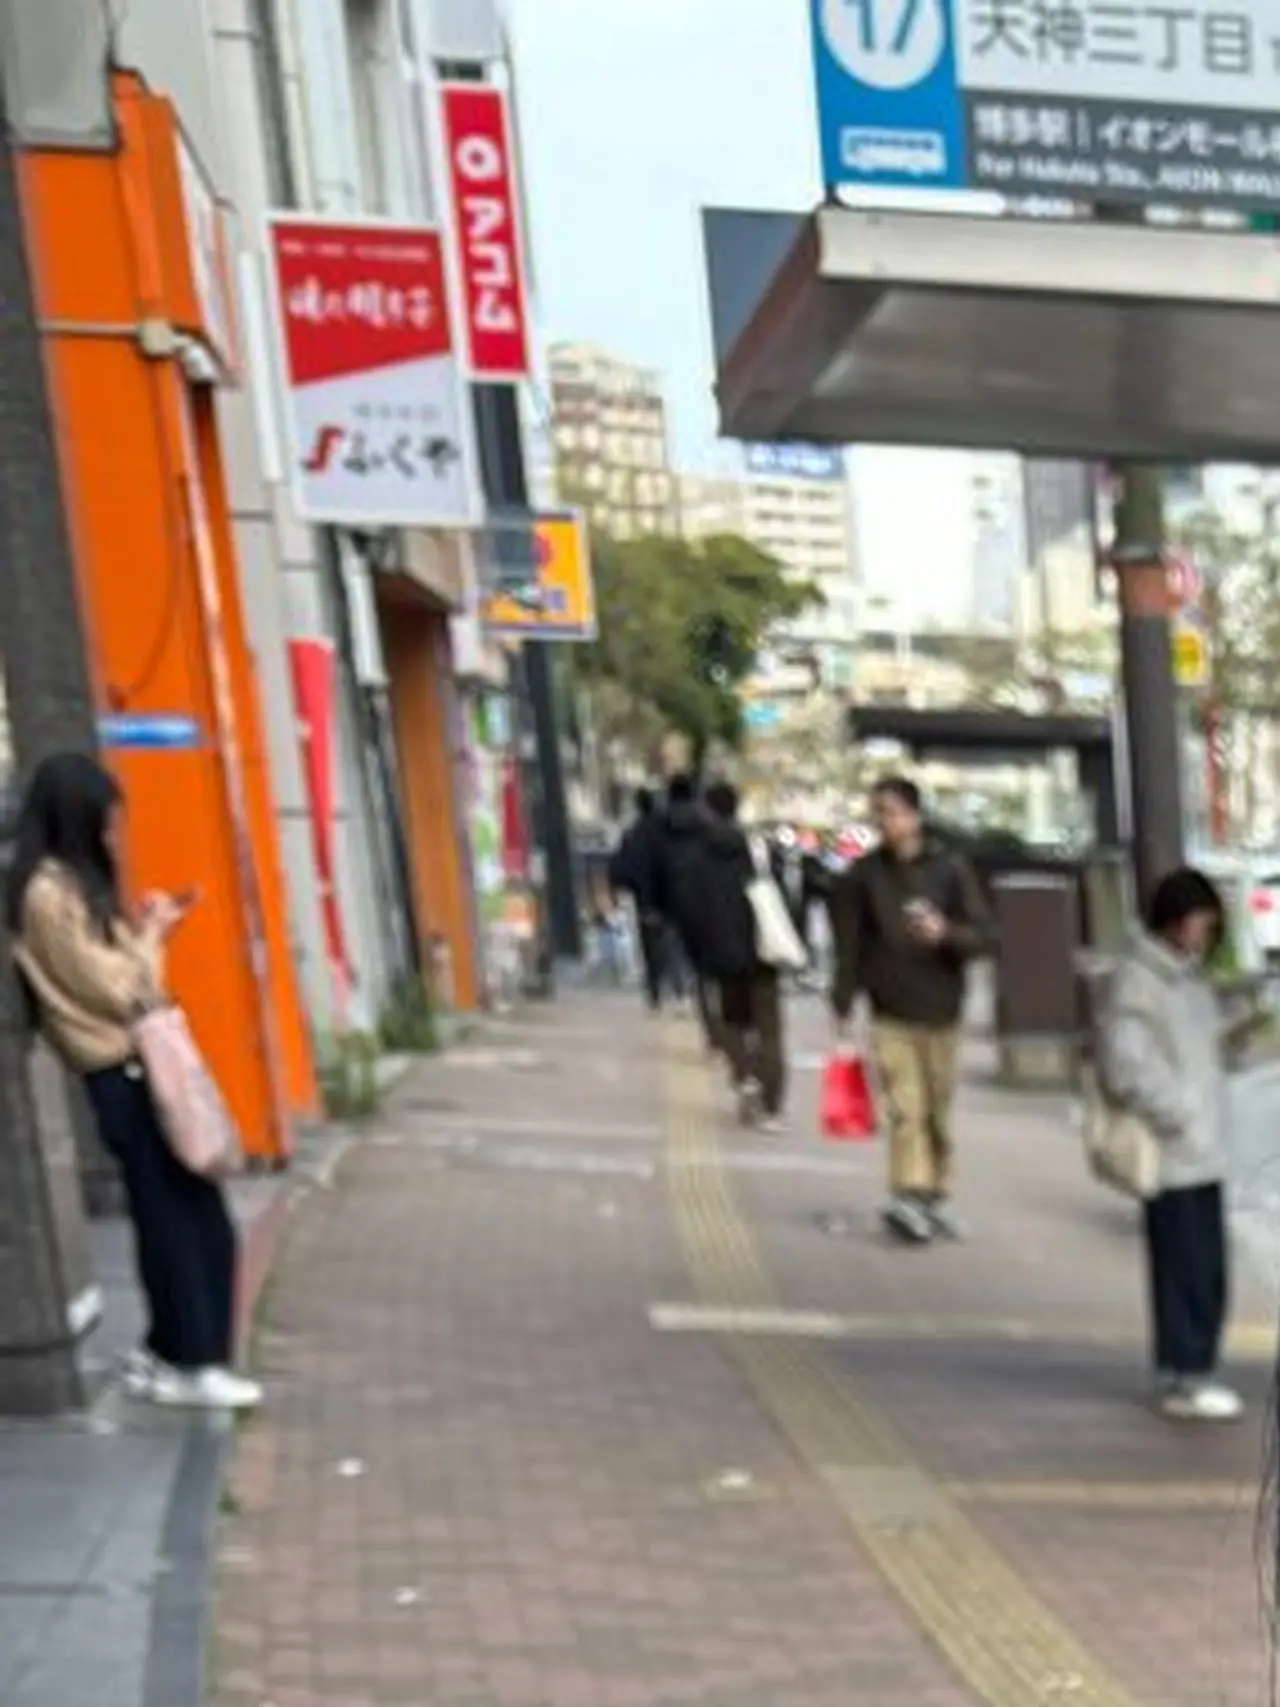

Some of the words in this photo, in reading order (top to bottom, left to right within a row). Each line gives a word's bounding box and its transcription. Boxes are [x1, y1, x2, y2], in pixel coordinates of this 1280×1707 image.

[970, 0, 1253, 75] 天神三丁目
